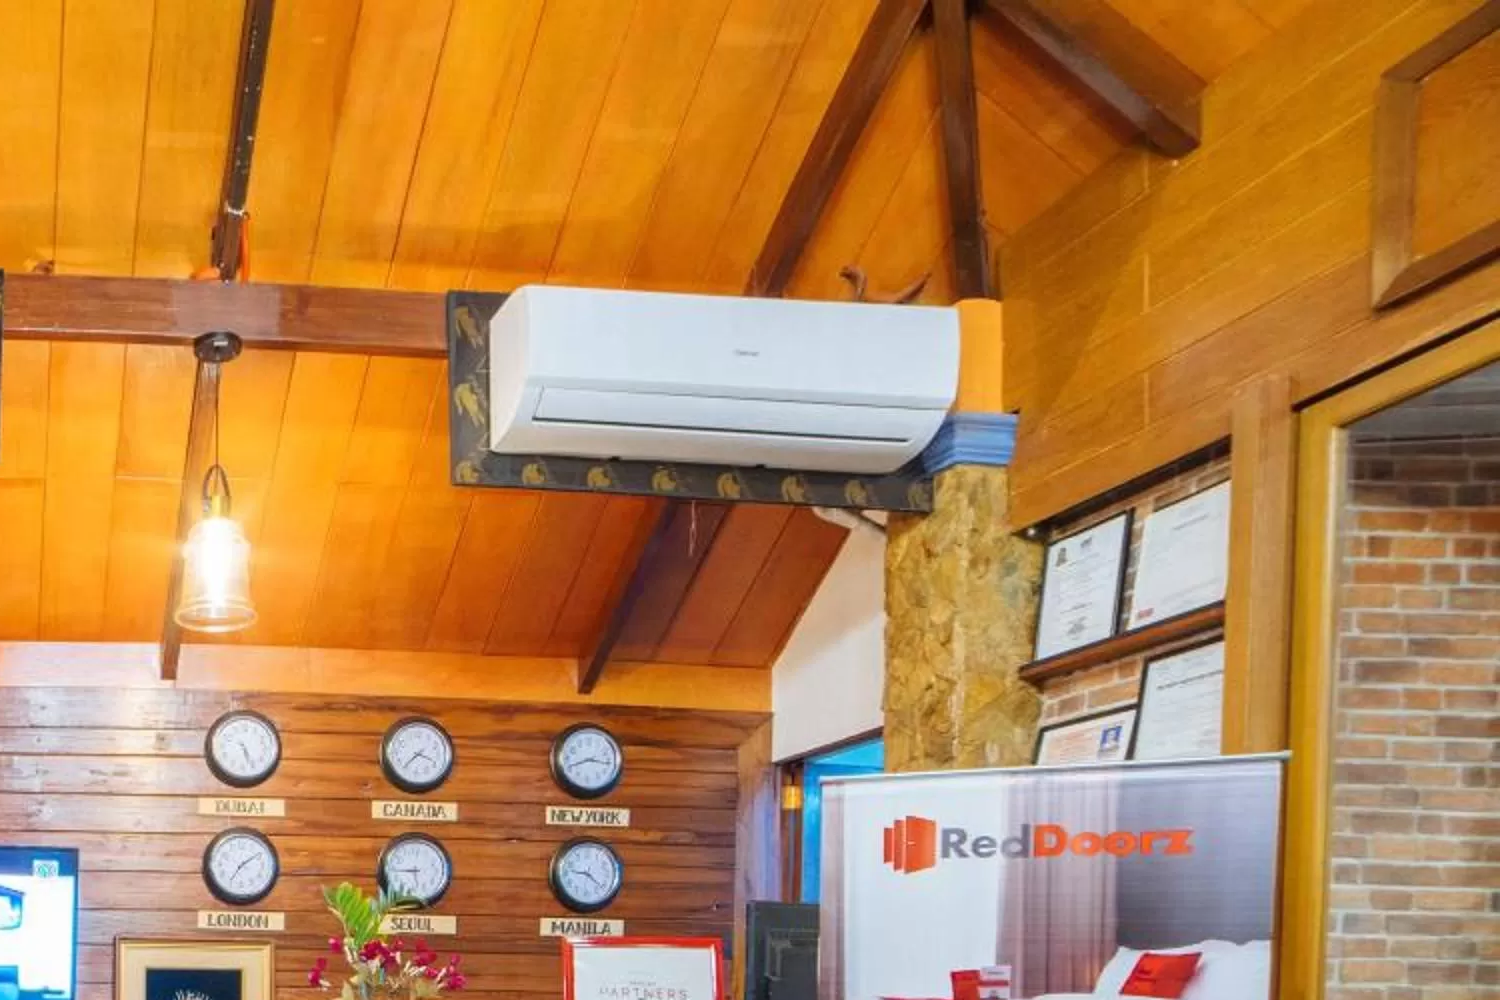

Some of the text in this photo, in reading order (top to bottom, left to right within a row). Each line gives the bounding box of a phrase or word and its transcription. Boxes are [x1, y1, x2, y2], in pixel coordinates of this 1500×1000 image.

[215, 800, 266, 814] DUBAI
[383, 803, 447, 819] CANADA
[940, 823, 1195, 859] RedDoorz
[207, 914, 268, 928] LONDON
[391, 917, 433, 932] SEOUL
[551, 921, 612, 935] MANILA
